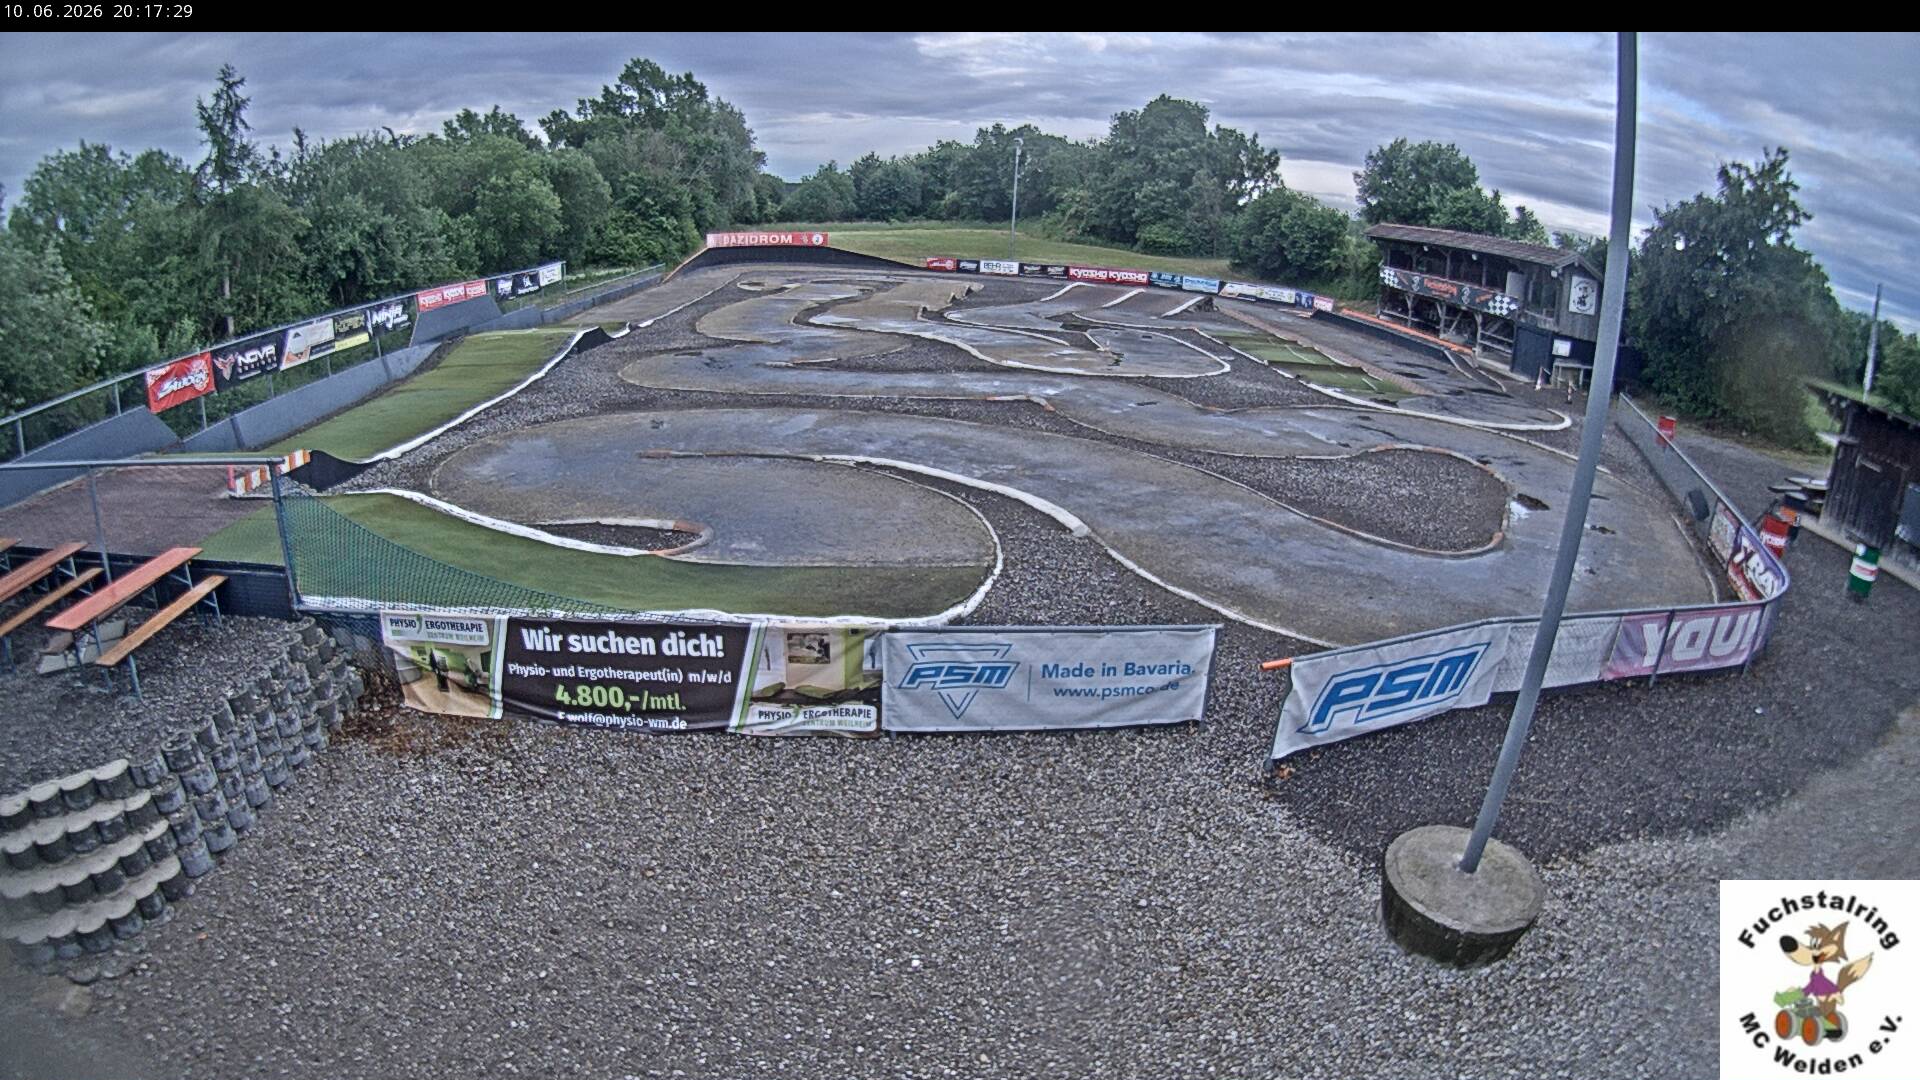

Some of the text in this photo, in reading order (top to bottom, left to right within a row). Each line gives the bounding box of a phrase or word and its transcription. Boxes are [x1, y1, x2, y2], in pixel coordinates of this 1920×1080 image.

[1069, 267, 1108, 280] KYOSHO
[1109, 269, 1148, 282] KYOSHO
[239, 344, 277, 367] NOVA
[389, 618, 484, 633] PHYSIO ERGOTHERAPIE
[520, 626, 725, 658] Wir suchen dich!
[507, 662, 732, 684] Physio- und Ergotherapeut(in) m/w/d
[905, 664, 1013, 688] PSM
[1041, 660, 1196, 679] Made in Bavaria.
[1053, 680, 1180, 698] www.psmco.de
[1311, 649, 1480, 726] PSM
[758, 708, 872, 720] PHYSIO ERGOTHERAPIE
